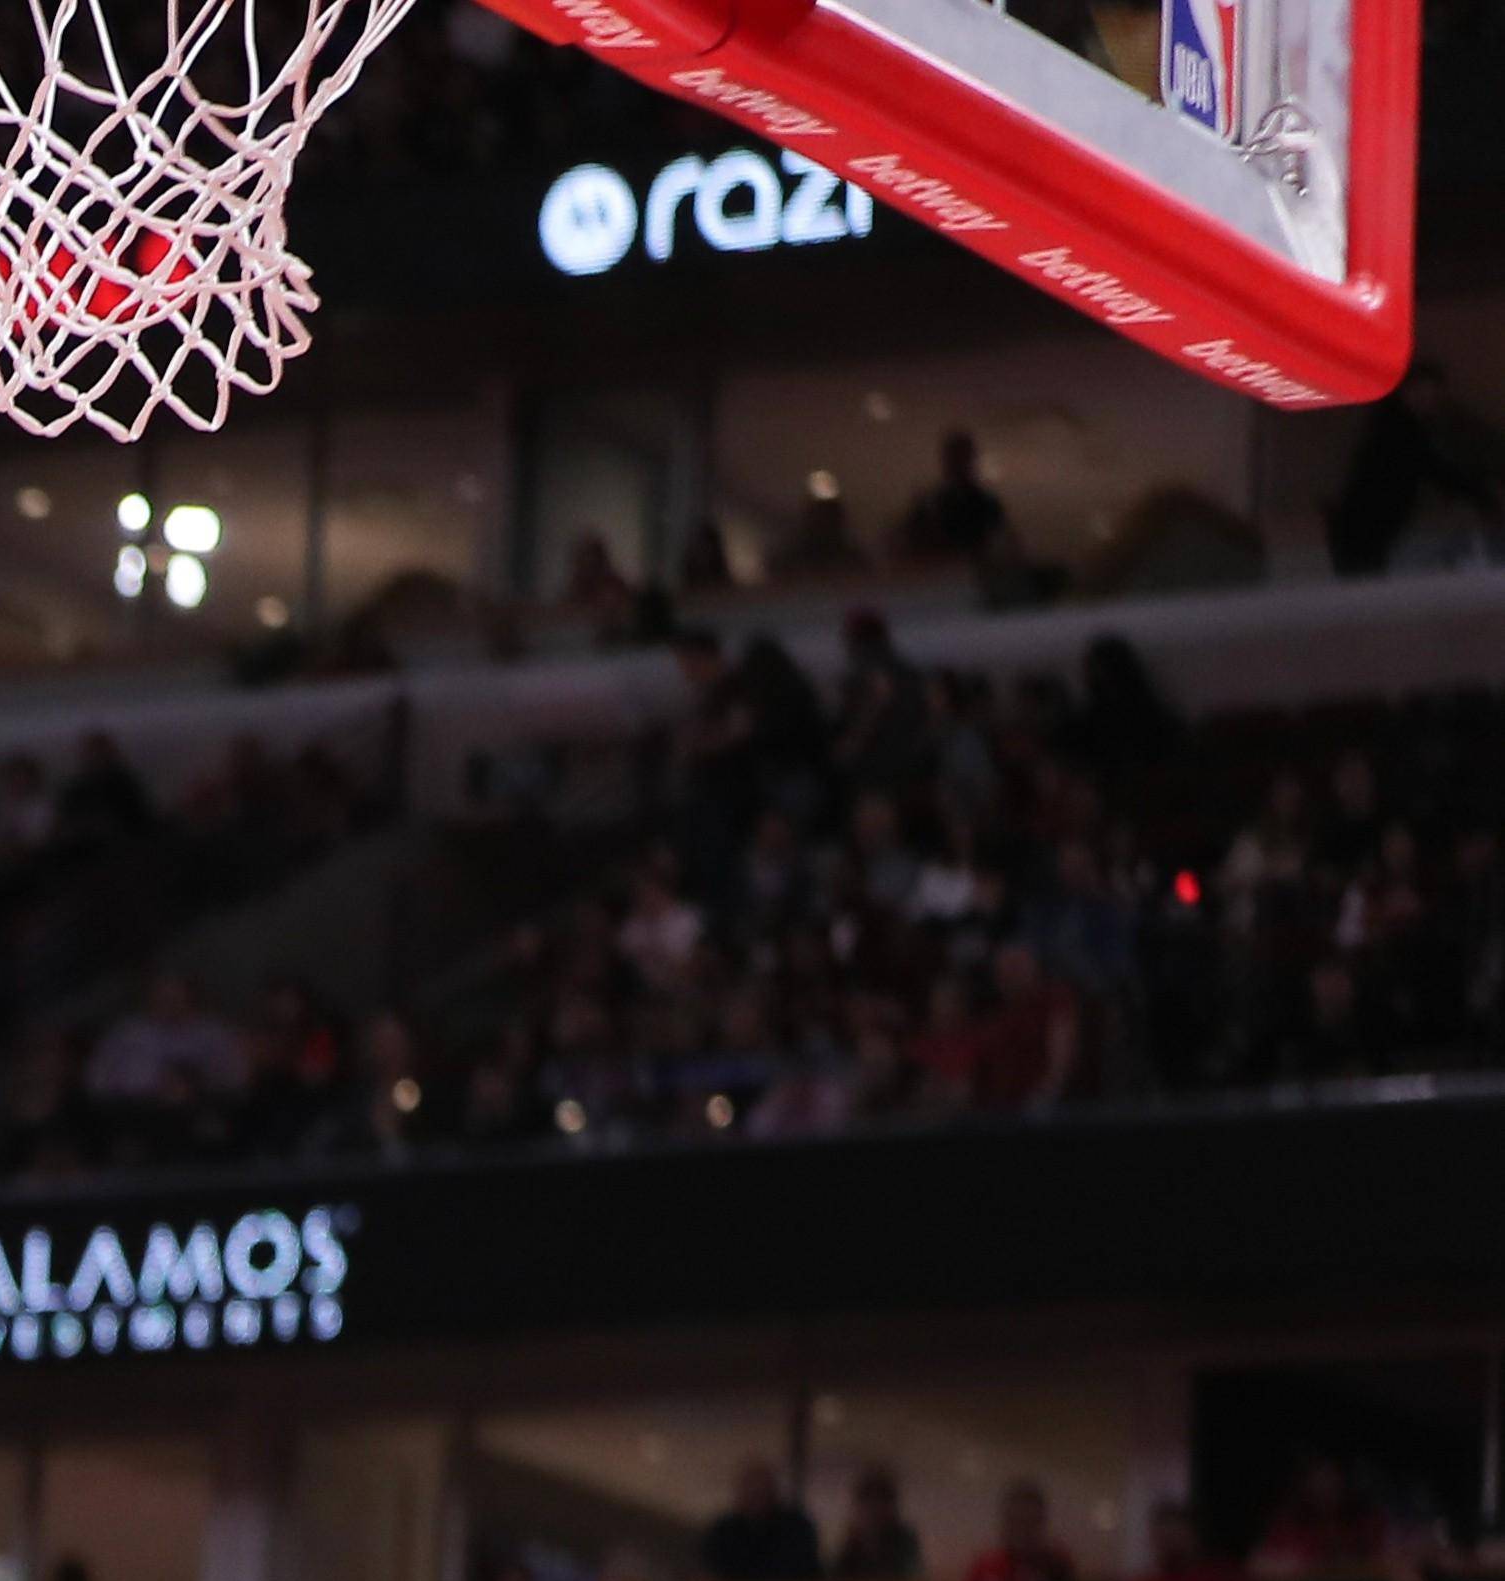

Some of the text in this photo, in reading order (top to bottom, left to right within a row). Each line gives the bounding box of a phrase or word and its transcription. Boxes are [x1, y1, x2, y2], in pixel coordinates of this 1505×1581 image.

[668, 67, 839, 136] betway
[847, 153, 1010, 233] betway
[1017, 246, 1176, 326] betway
[1181, 338, 1329, 402] betway
